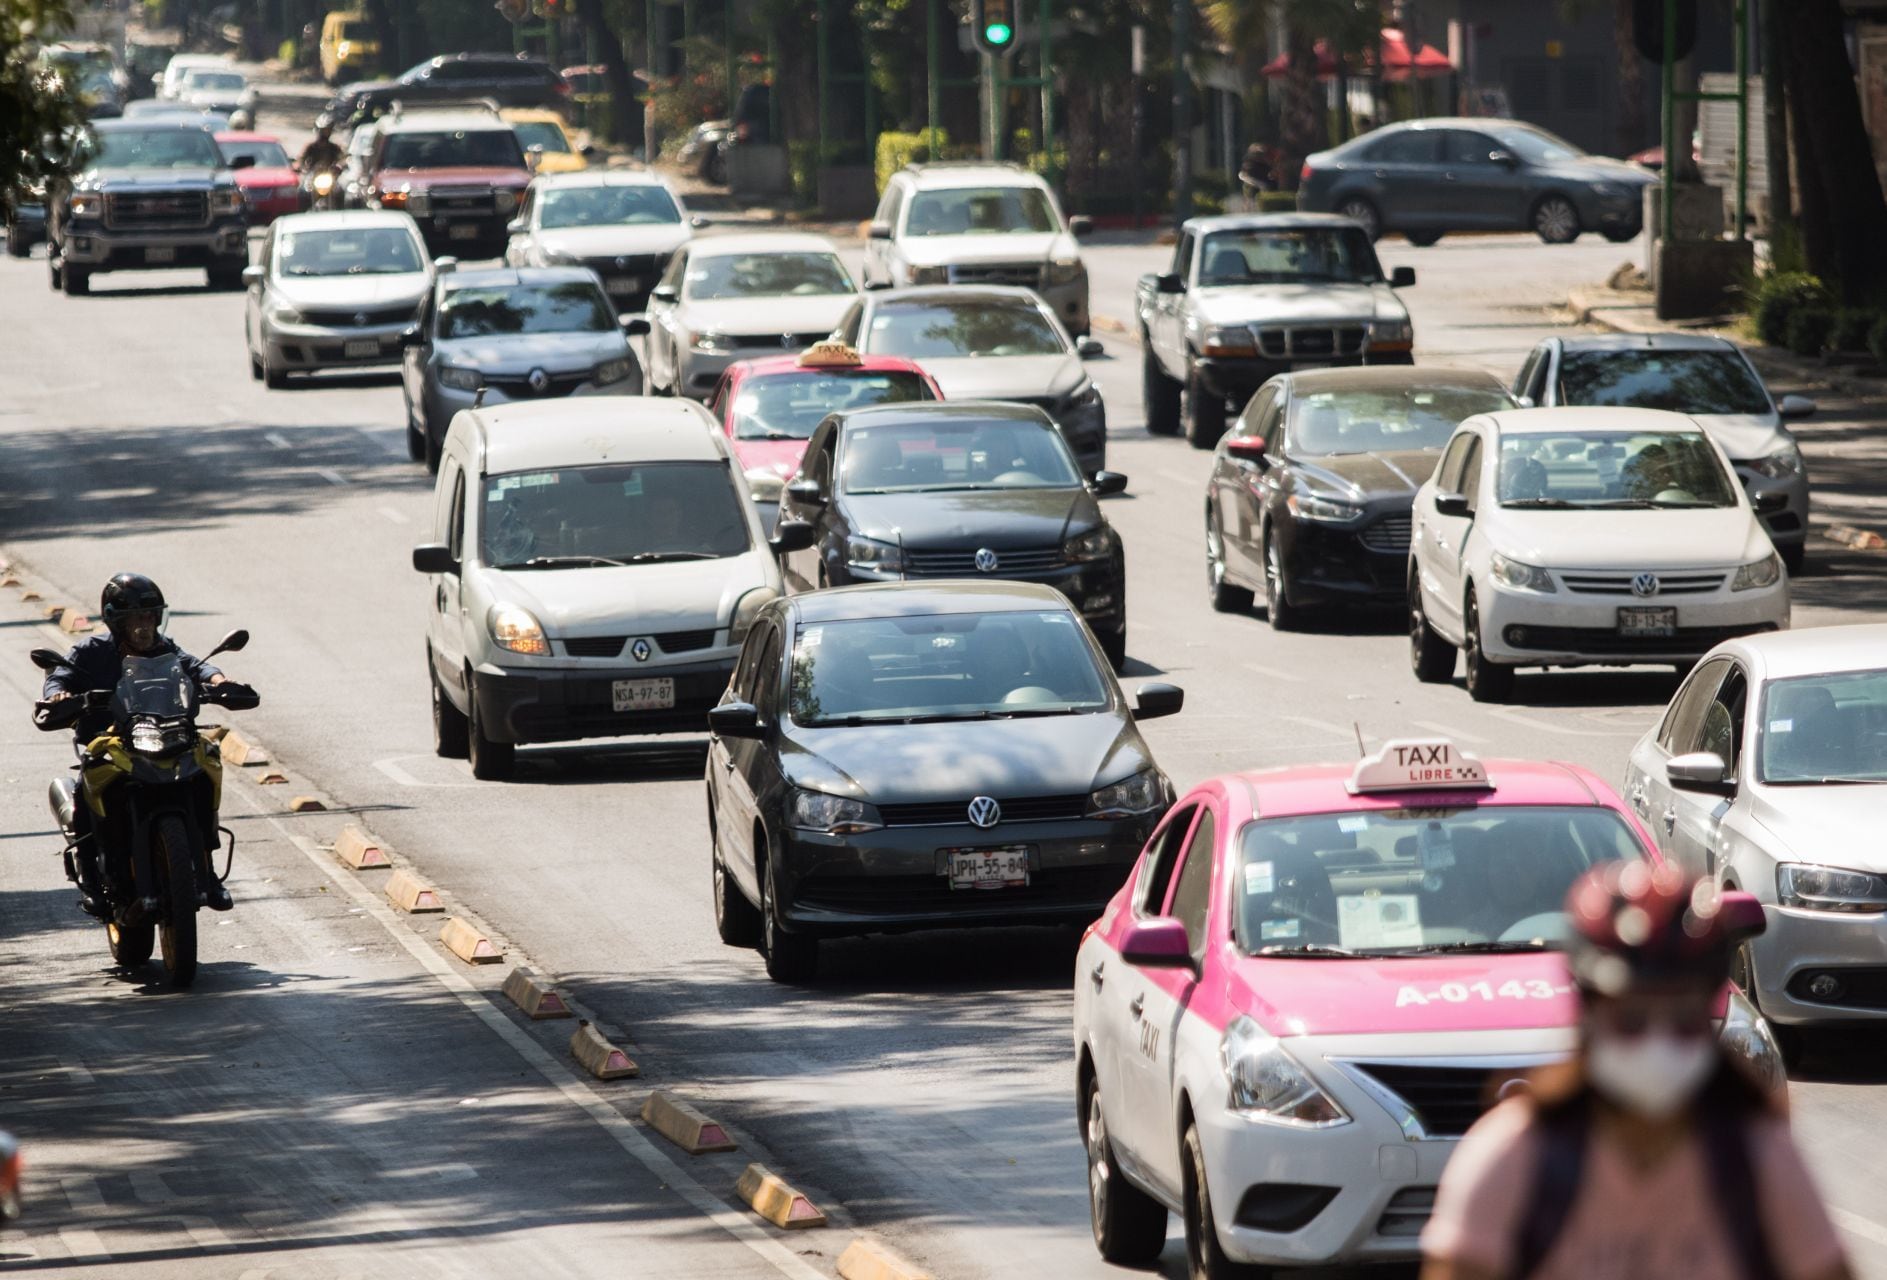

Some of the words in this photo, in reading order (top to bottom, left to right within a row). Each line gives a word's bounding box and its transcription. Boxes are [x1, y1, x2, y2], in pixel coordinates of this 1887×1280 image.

[817, 344, 845, 354] TAXI
[614, 686, 672, 702] NSA-97-87
[1393, 744, 1449, 767] TAXI
[1409, 768, 1453, 781] LIBRE
[953, 858, 1025, 877] JPH-55-84
[1395, 979, 1576, 1008] A-0143-
[1139, 1018, 1160, 1064] TAXI
